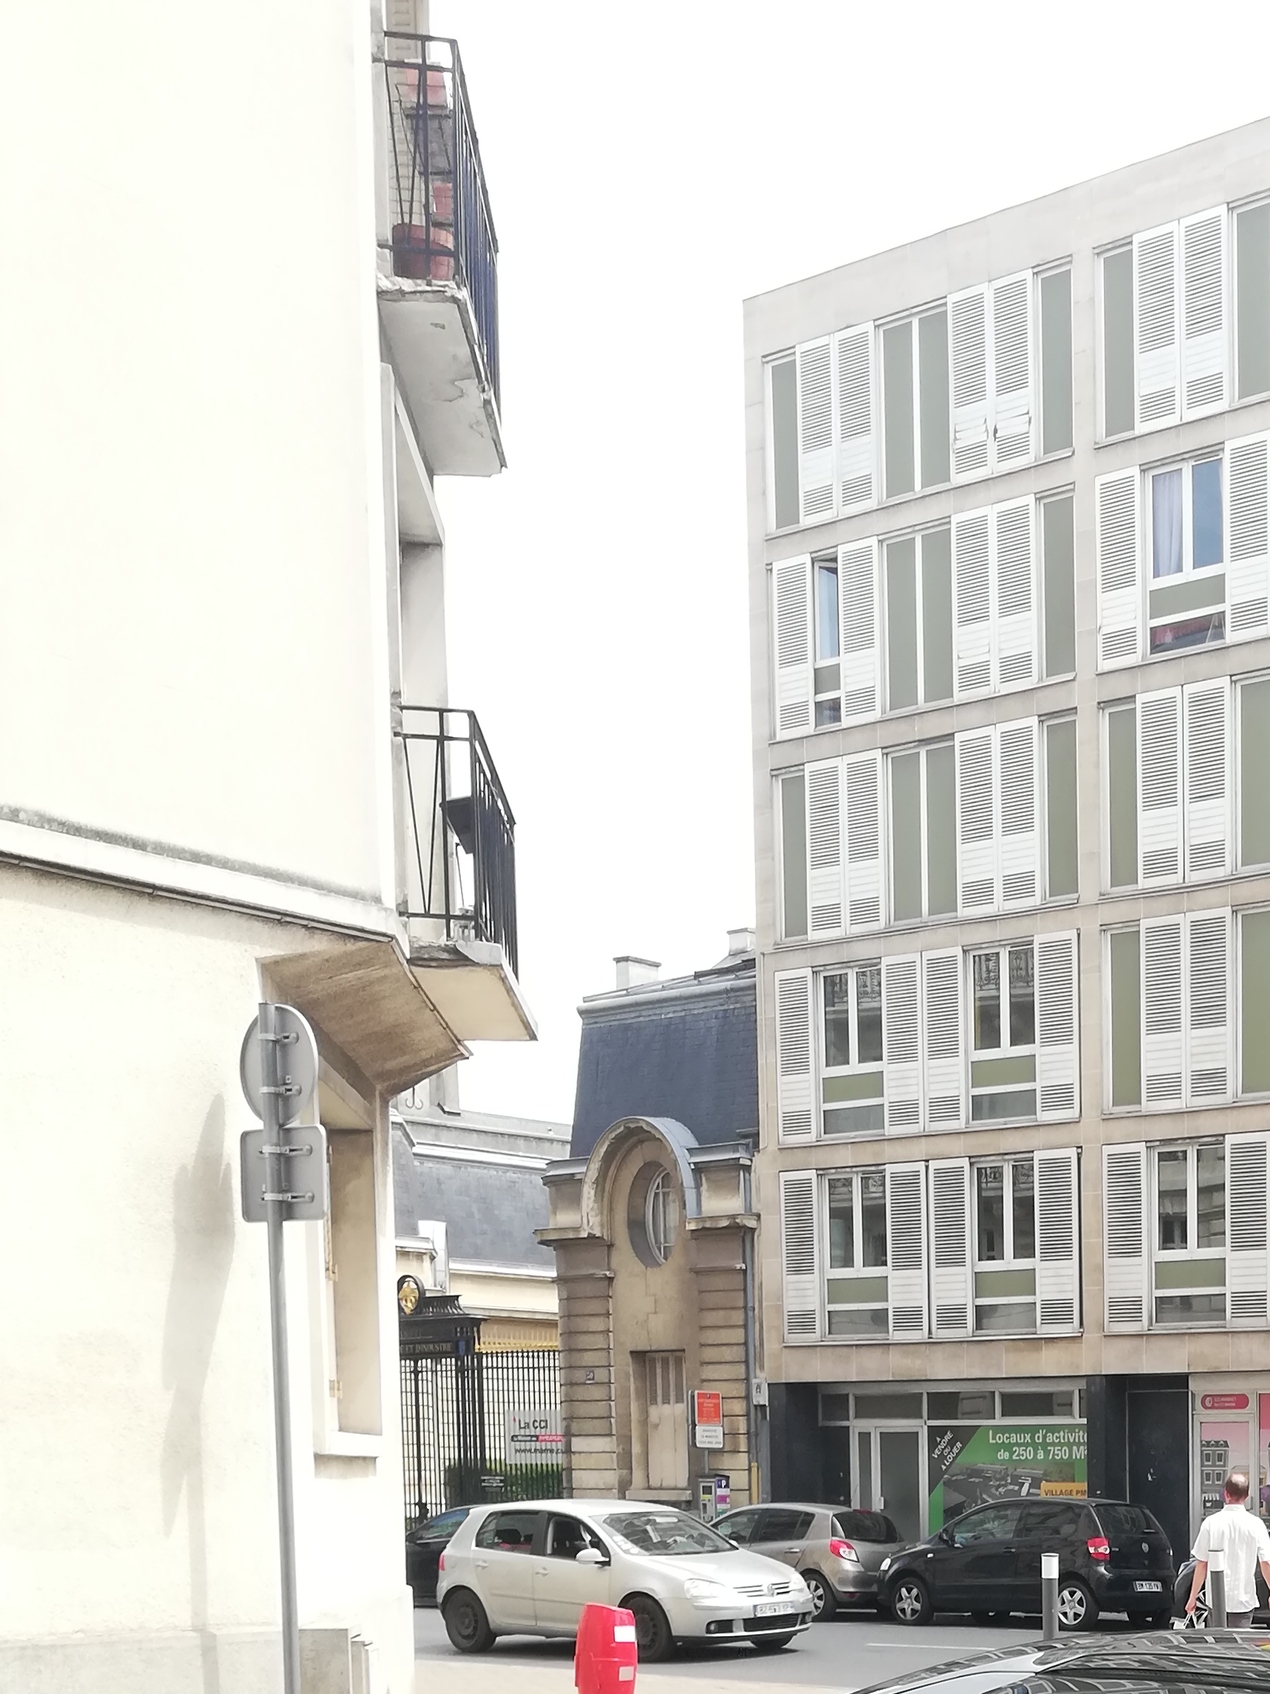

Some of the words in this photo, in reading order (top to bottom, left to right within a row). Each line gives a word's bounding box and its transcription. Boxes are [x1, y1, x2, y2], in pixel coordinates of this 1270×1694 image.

[518, 1419, 530, 1430] La
[532, 1419, 548, 1430] CCI
[989, 1429, 1031, 1444] Locaux
[931, 1430, 954, 1458] VENDRE
[944, 1441, 963, 1466] LOUER
[997, 1449, 1010, 1460] de
[1012, 1446, 1033, 1460] 250
[1037, 1447, 1044, 1459] à
[1048, 1446, 1069, 1459] 750
[1044, 1489, 1074, 1497] VILLAGE
